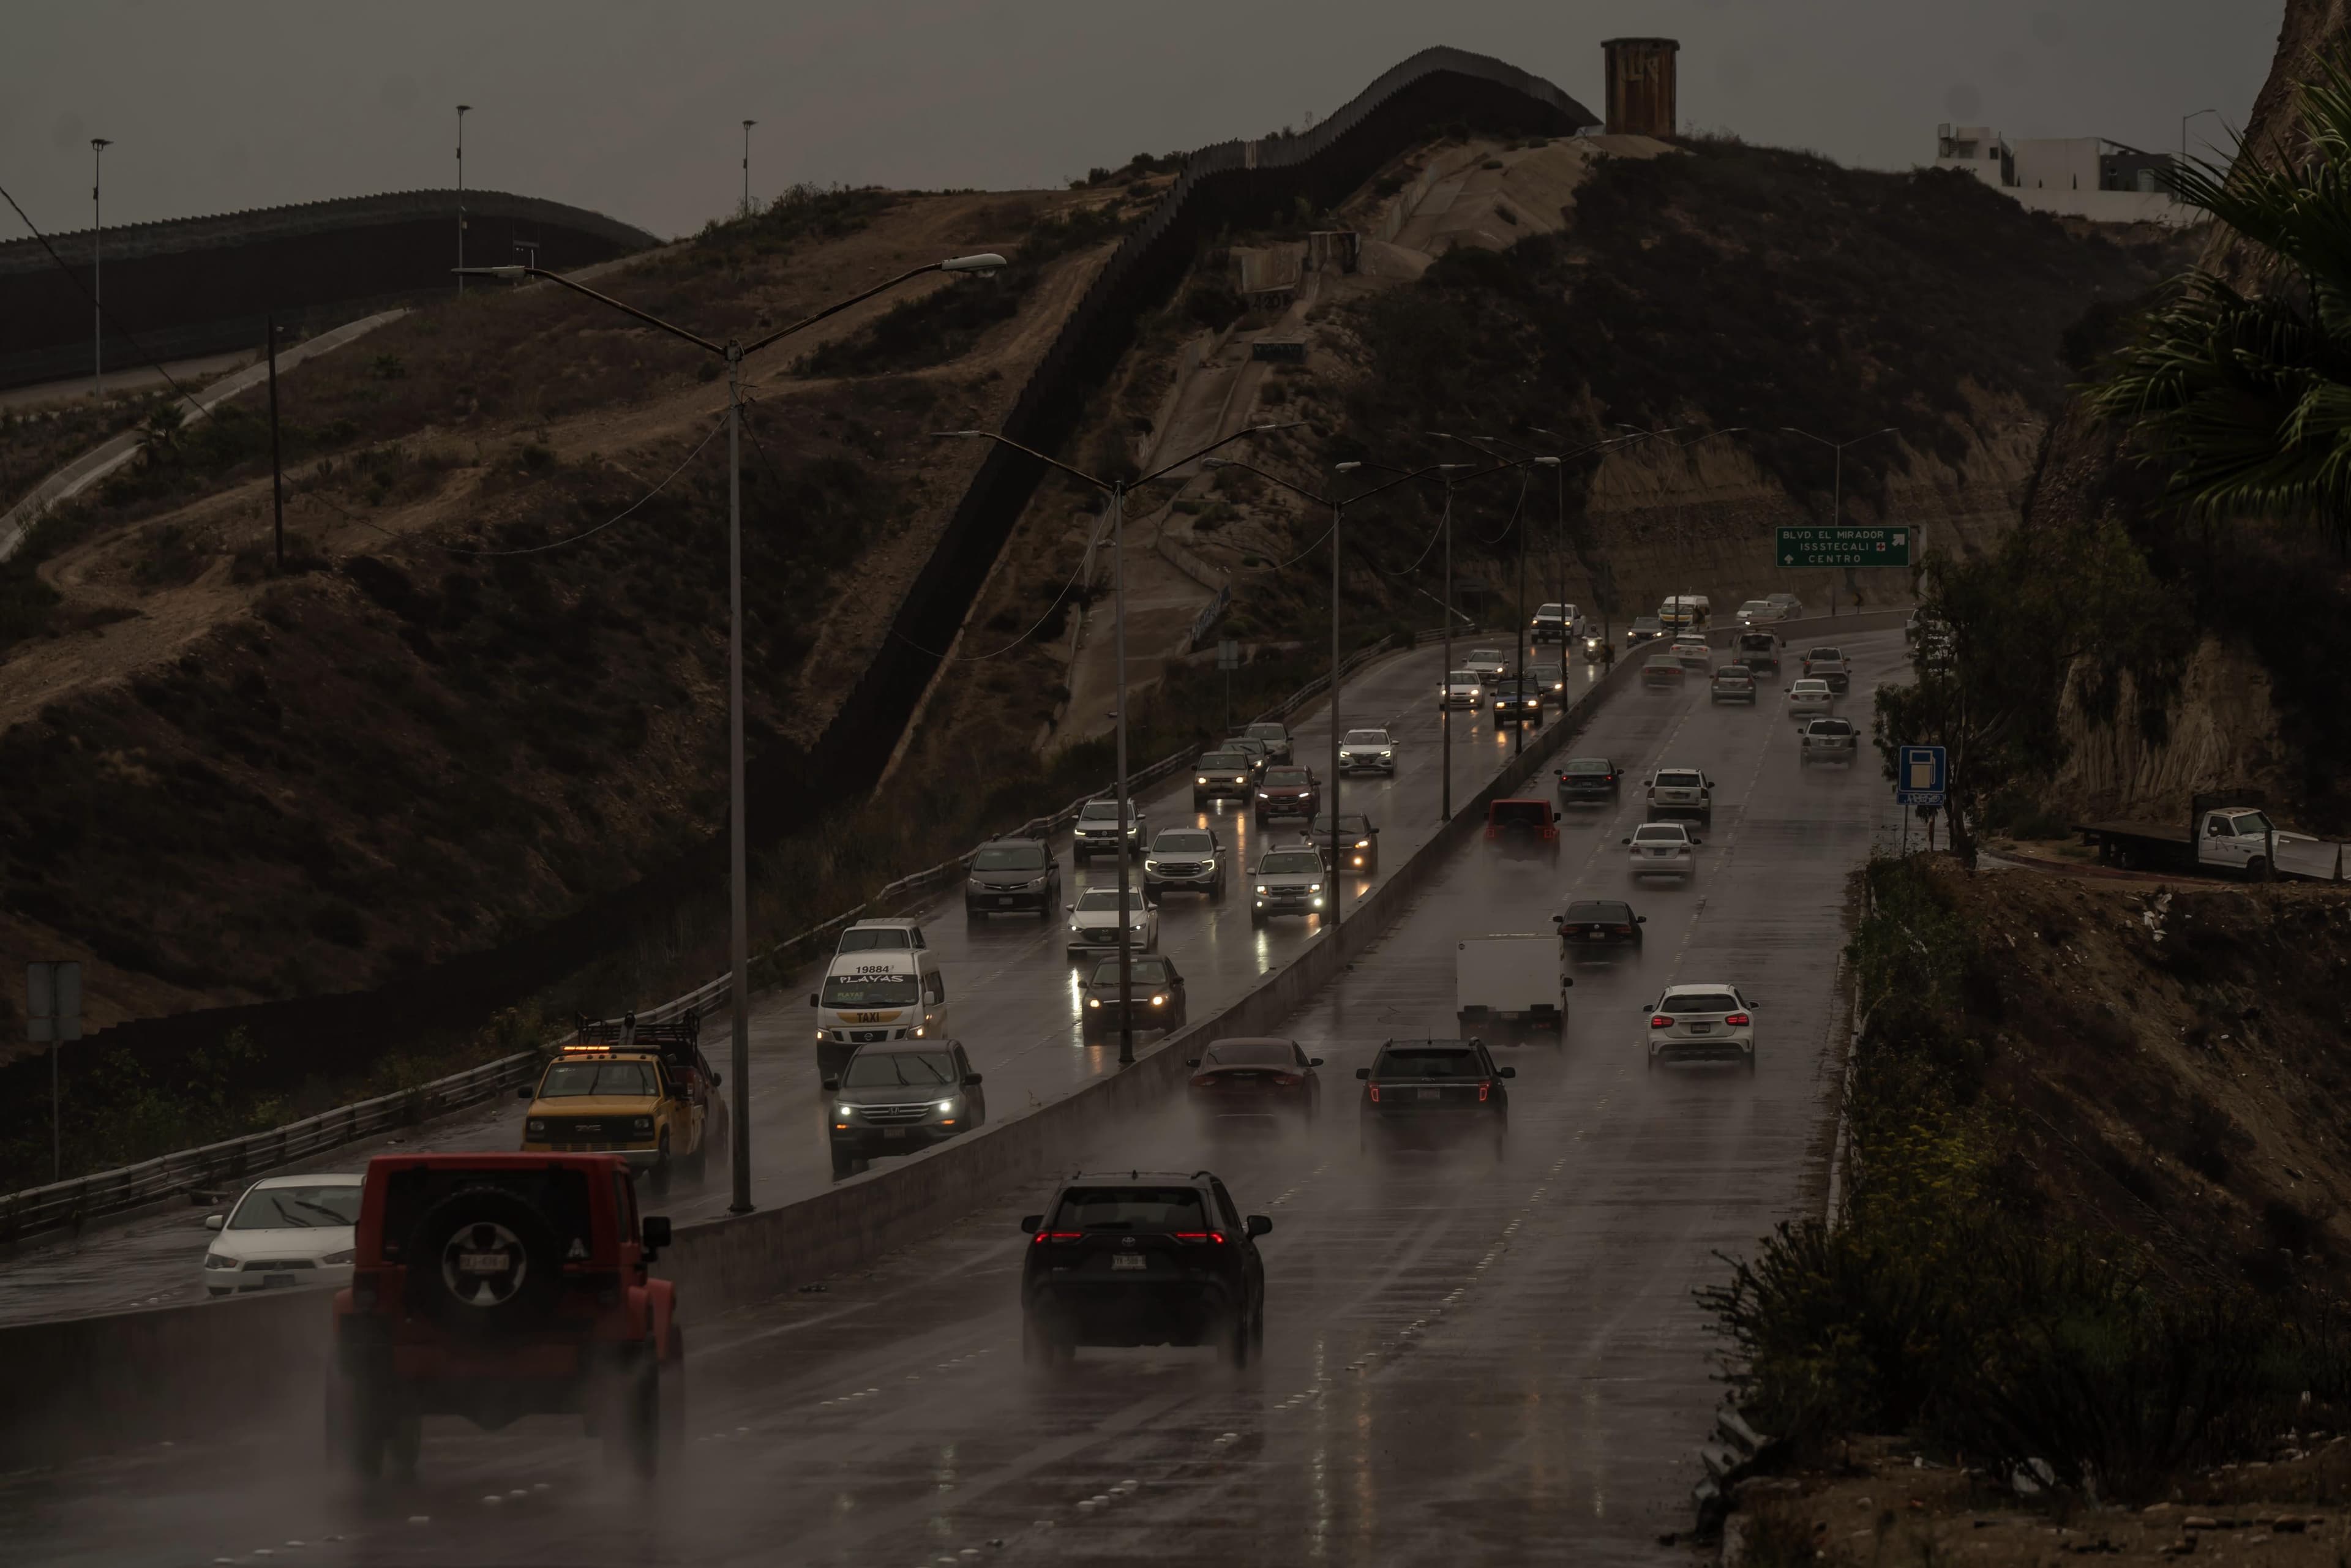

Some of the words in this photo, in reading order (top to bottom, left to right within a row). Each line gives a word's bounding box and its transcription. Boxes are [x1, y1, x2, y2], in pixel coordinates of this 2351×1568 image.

[1837, 530, 1884, 539] MIRADOR
[1800, 542, 1869, 551] ISSSTECALI
[1809, 555, 1861, 563] CENTRO
[839, 975, 904, 984] PLAYAS
[857, 1013, 880, 1022] TAXI
